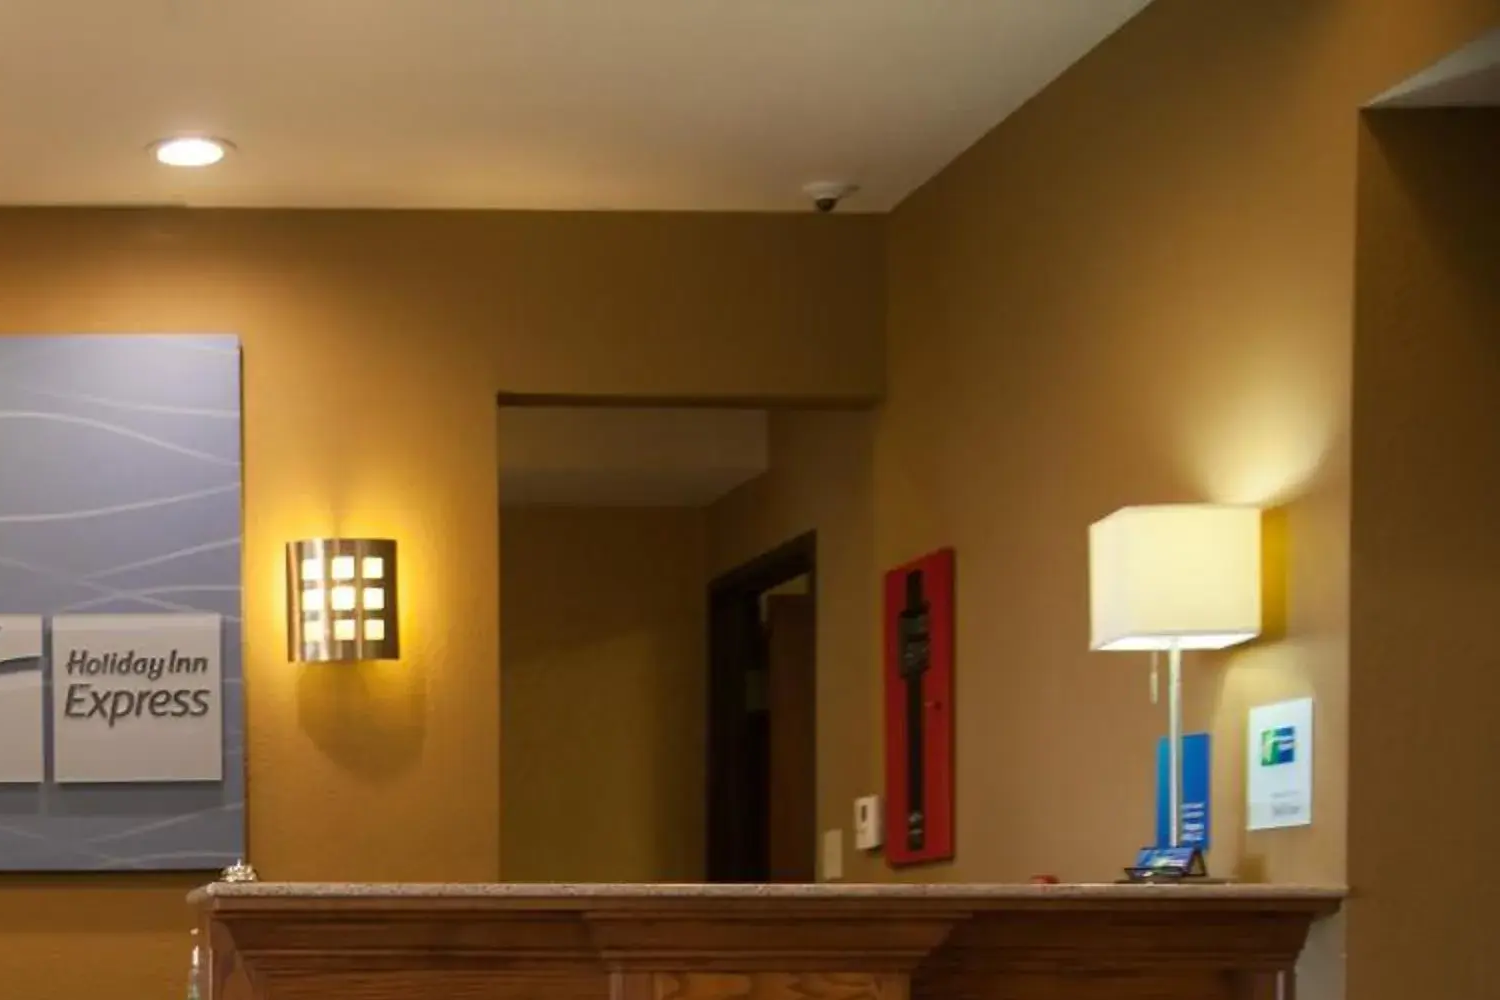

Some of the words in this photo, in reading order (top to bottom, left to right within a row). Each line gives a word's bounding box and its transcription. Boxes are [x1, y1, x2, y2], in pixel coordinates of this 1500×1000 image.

[66, 649, 164, 681] Holiday
[168, 649, 209, 673] Inn
[64, 683, 211, 728] Express
